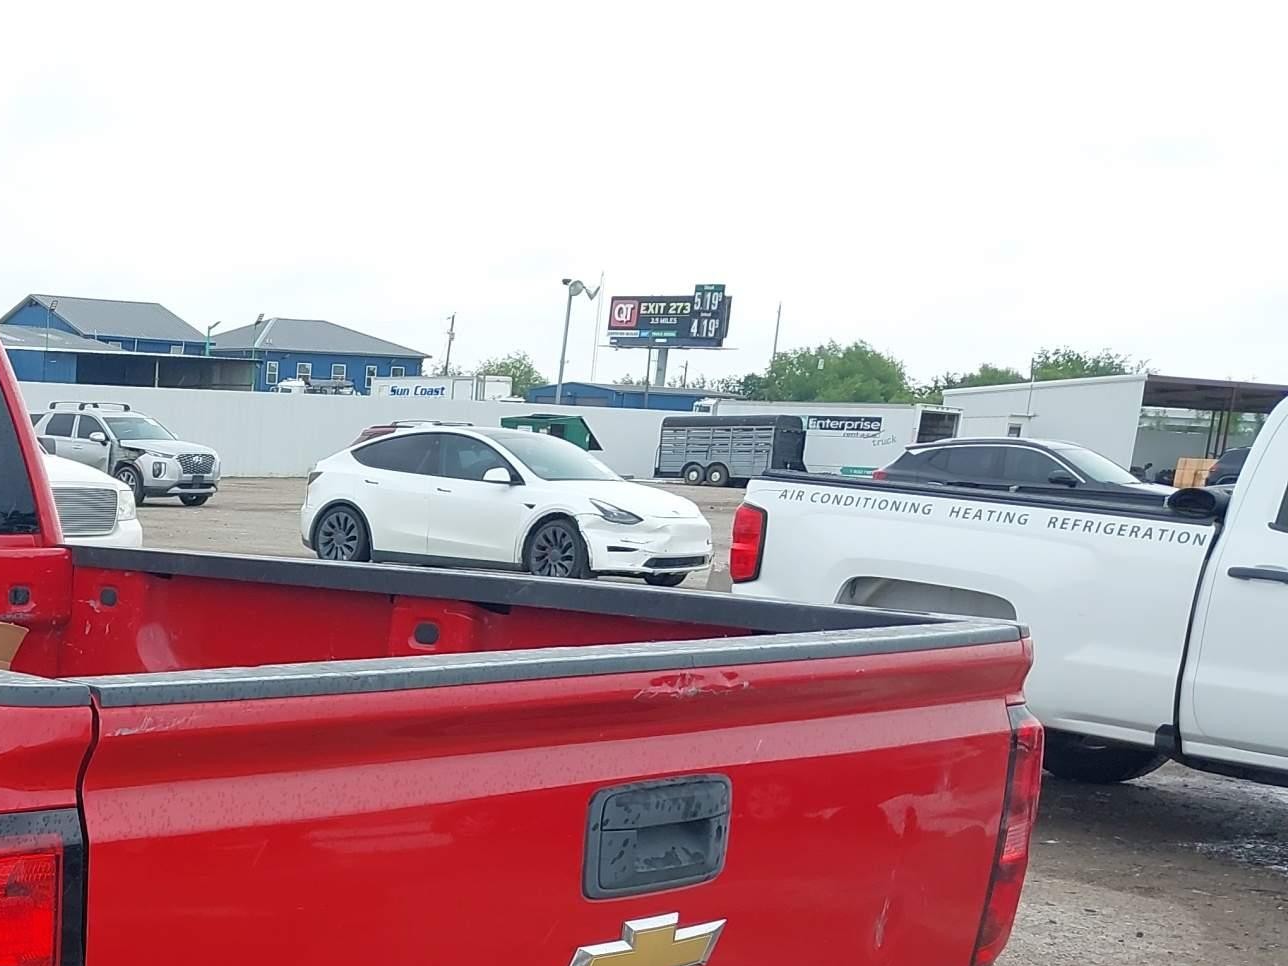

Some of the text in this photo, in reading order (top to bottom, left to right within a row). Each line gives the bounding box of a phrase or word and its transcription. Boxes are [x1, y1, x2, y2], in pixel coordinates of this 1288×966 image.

[614, 303, 634, 324] QT
[640, 302, 691, 314] EXIT 273
[390, 385, 446, 396] Sun Coast
[808, 417, 881, 431] Enterprise
[778, 489, 1208, 547] AIR CONDITIONING HEATING REFRIGERATION
